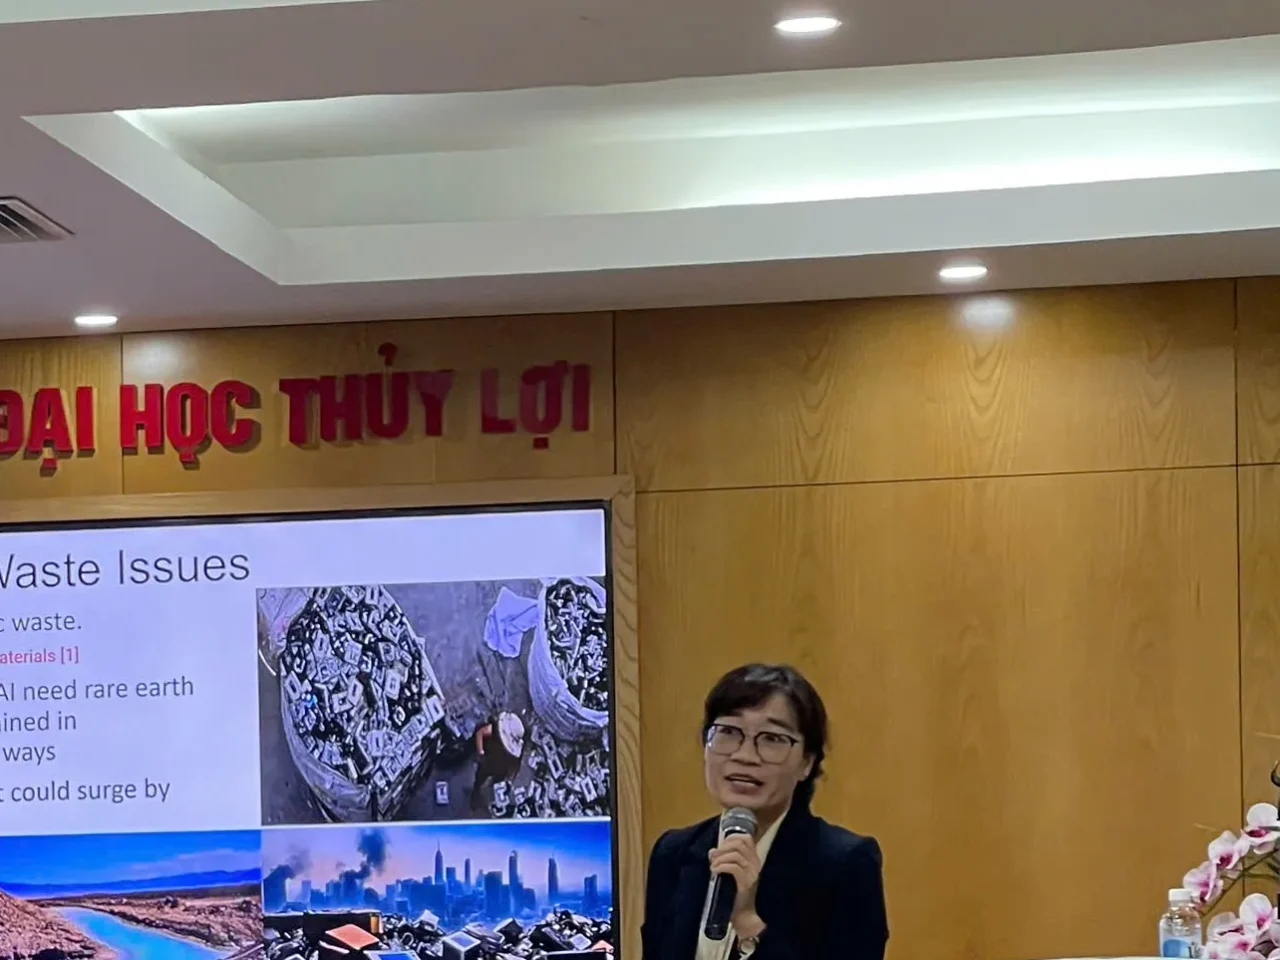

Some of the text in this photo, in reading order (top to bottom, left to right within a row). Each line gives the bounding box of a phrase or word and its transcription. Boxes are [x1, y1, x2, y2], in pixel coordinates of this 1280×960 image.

[119, 379, 261, 470] HỌC
[278, 342, 455, 445] THỦY
[480, 359, 590, 449] LỢI
[119, 549, 250, 585] Issues
[12, 612, 82, 632] waste.
[60, 645, 79, 664] [1]
[23, 679, 77, 701] need
[85, 682, 128, 699] rare
[135, 675, 194, 698] earth
[58, 711, 77, 731] in
[2, 744, 56, 765] ways
[11, 780, 70, 802] could
[77, 782, 137, 803] surge
[144, 777, 171, 802] by
